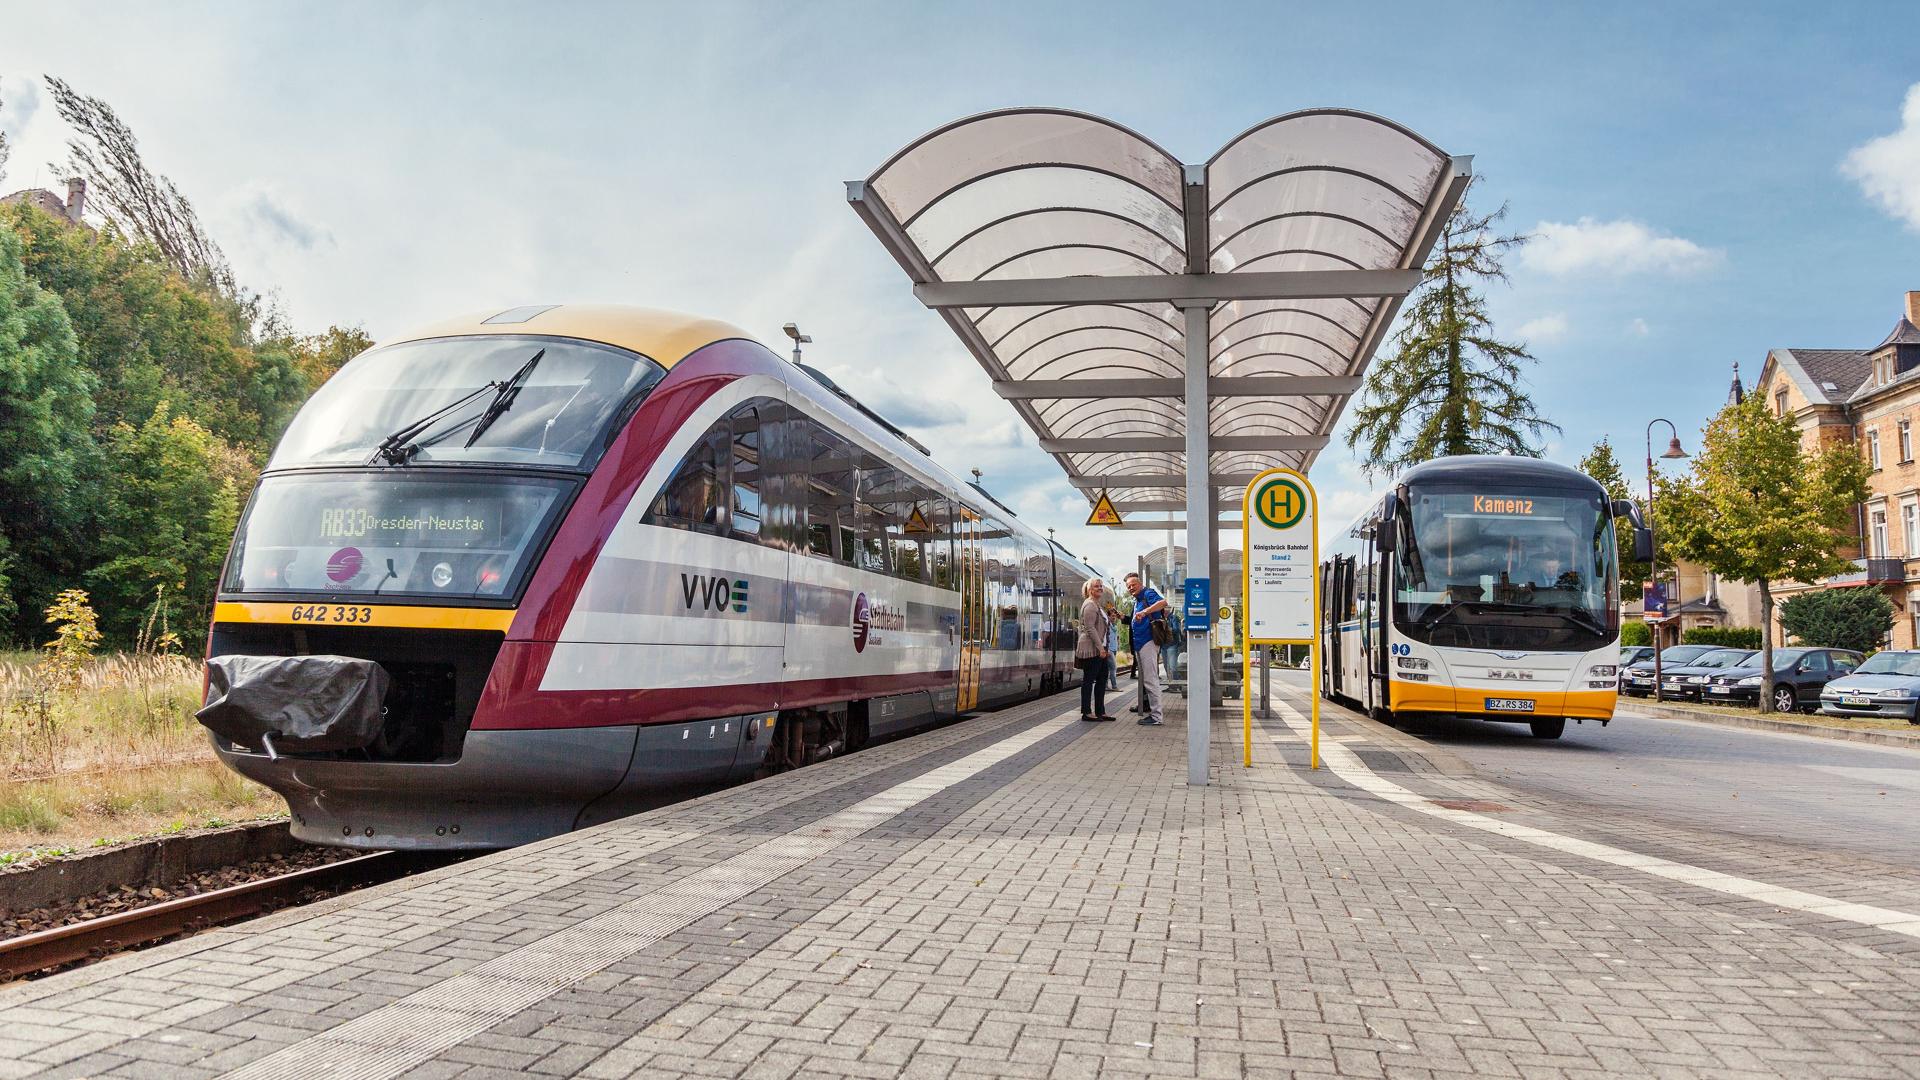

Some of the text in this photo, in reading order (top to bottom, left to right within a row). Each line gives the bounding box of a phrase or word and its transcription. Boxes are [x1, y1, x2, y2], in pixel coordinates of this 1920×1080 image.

[1270, 490, 1291, 518] H
[1473, 495, 1533, 514] Kamenz
[320, 508, 367, 537] RB33
[681, 573, 729, 612] VVO
[292, 605, 372, 623] 642 333
[869, 602, 905, 632] Städtebahn
[1488, 669, 1533, 680] MAN
